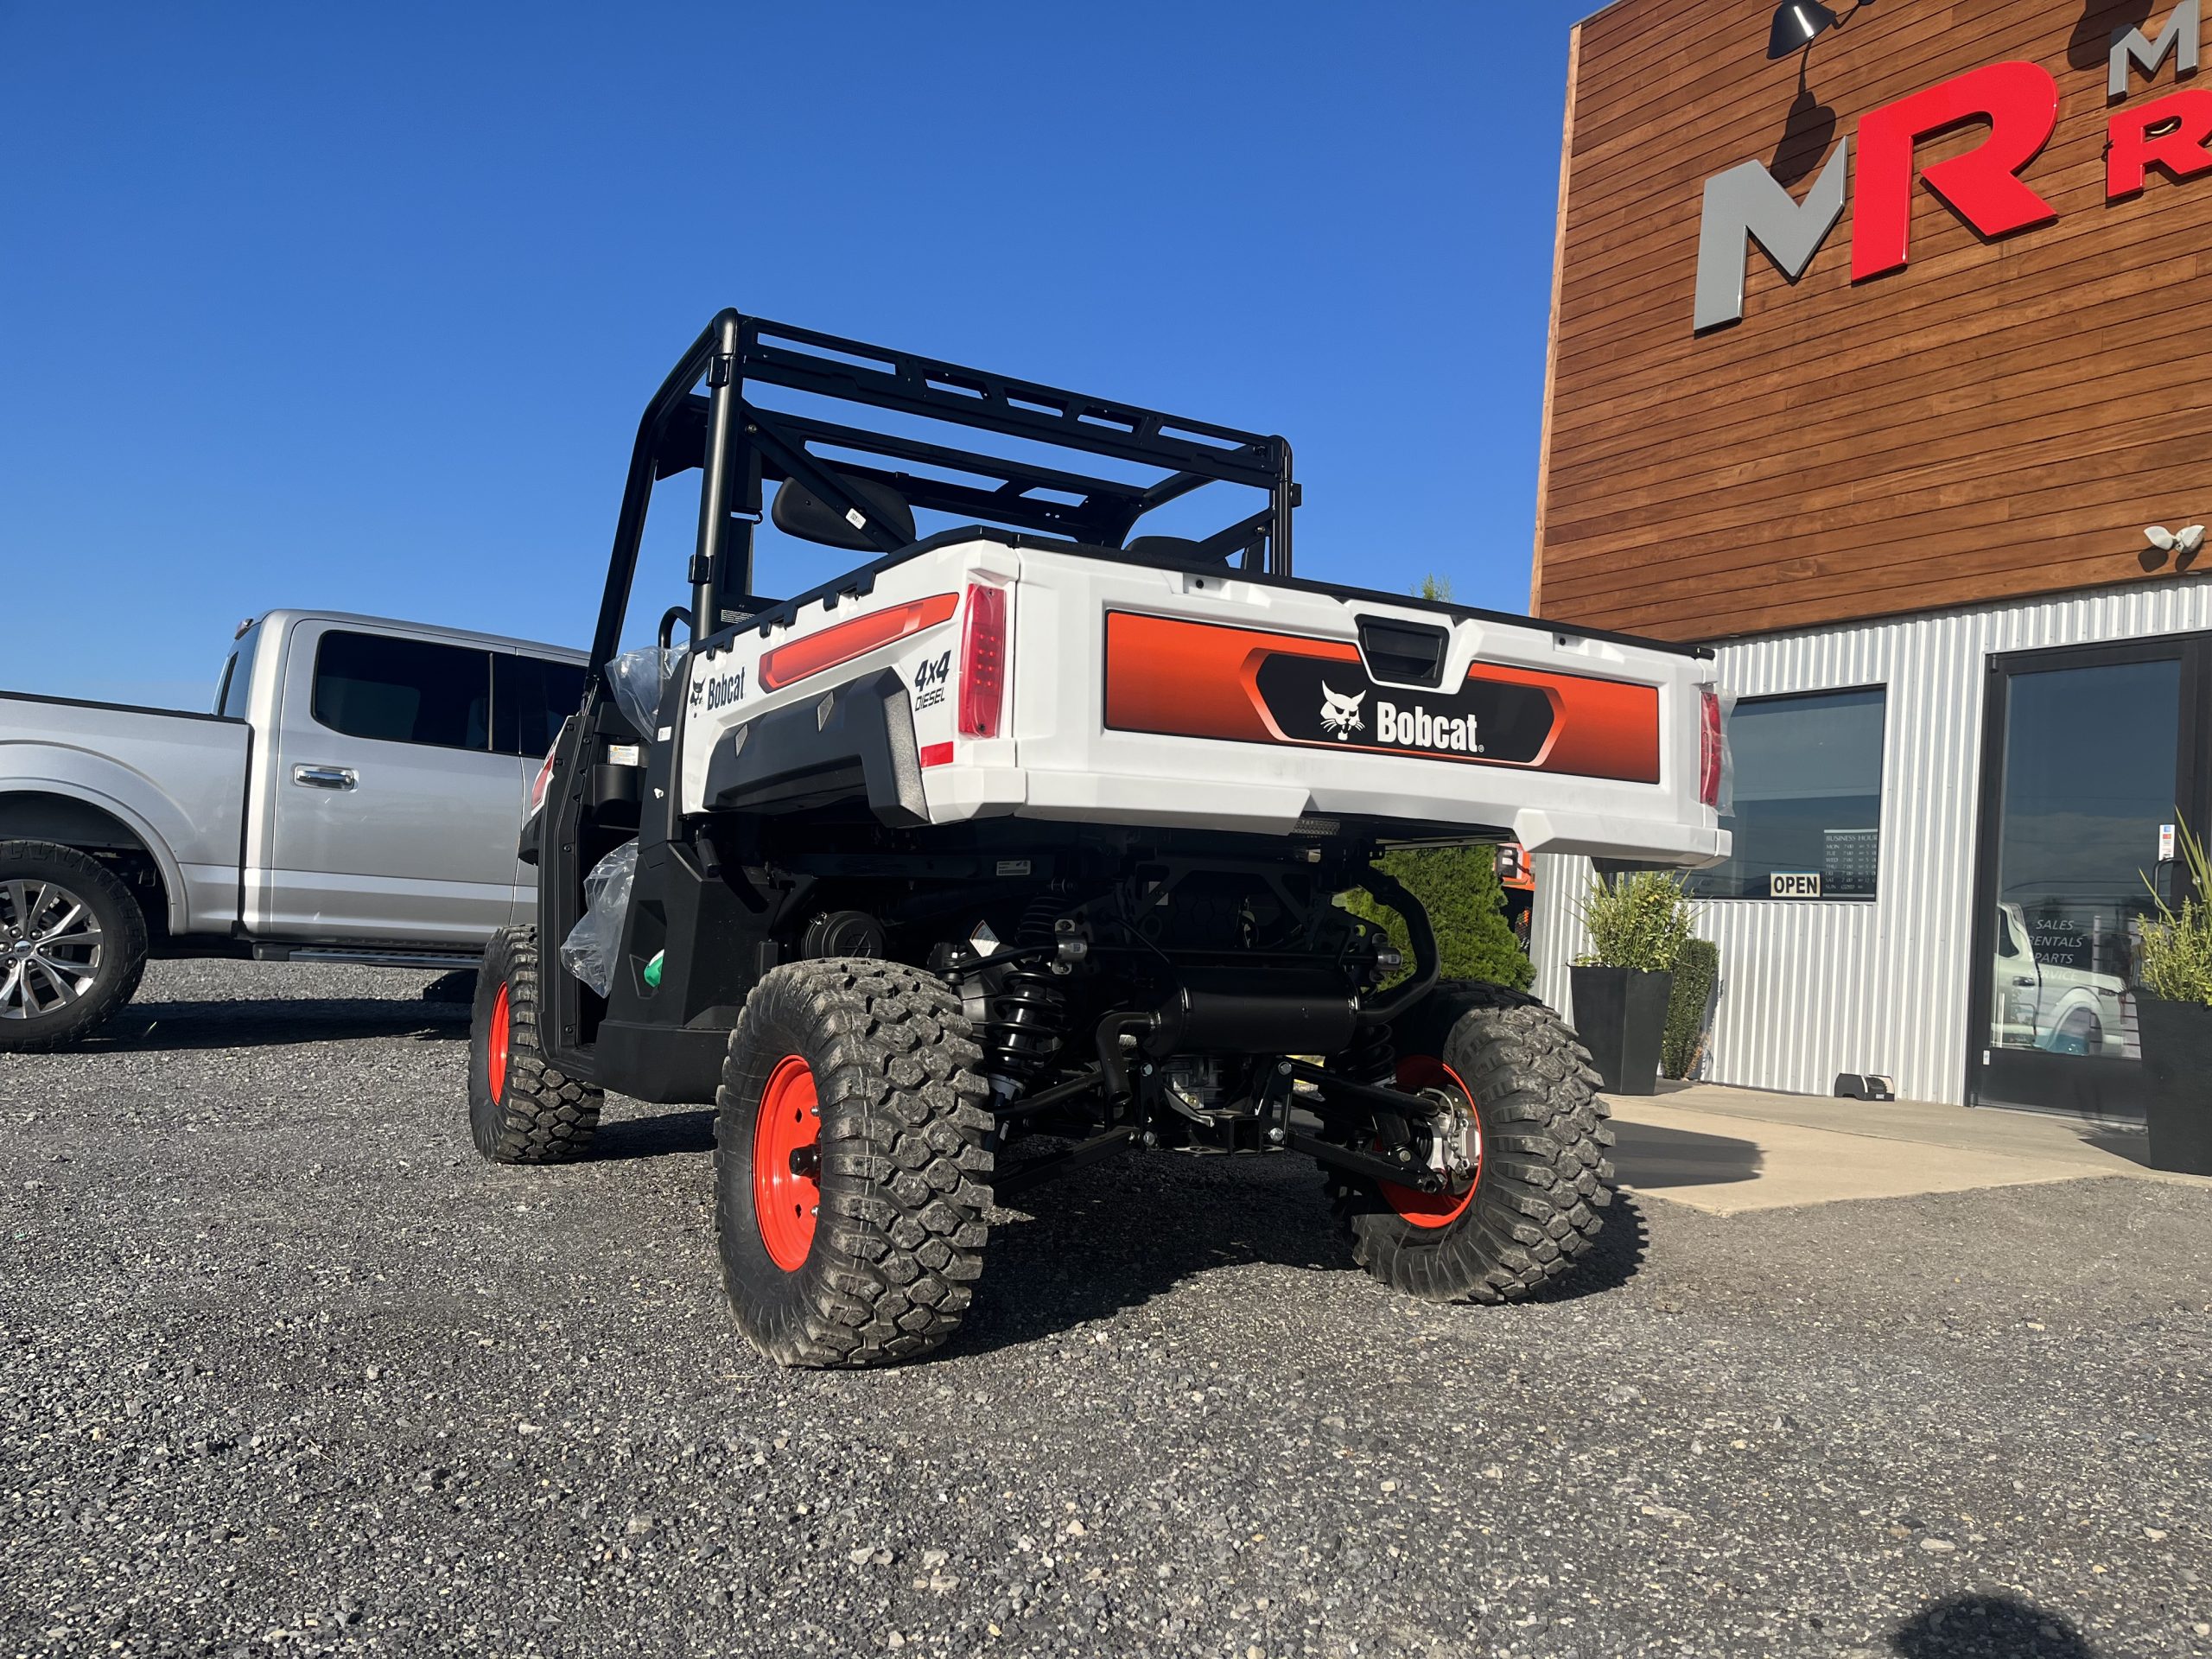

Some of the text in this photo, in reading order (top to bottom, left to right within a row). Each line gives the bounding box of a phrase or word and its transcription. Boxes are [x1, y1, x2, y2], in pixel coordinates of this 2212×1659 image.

[914, 650, 951, 692] 4x4
[707, 666, 746, 711] Bobcat
[915, 687, 945, 712] DIESEL
[1376, 701, 1478, 753] Bobcat
[1774, 876, 1817, 893] OPEN
[2036, 919, 2075, 931] SALES
[2029, 936, 2084, 948] RENTALS
[2034, 952, 2075, 964] PARTS
[2029, 969, 2077, 981] SRVICE
